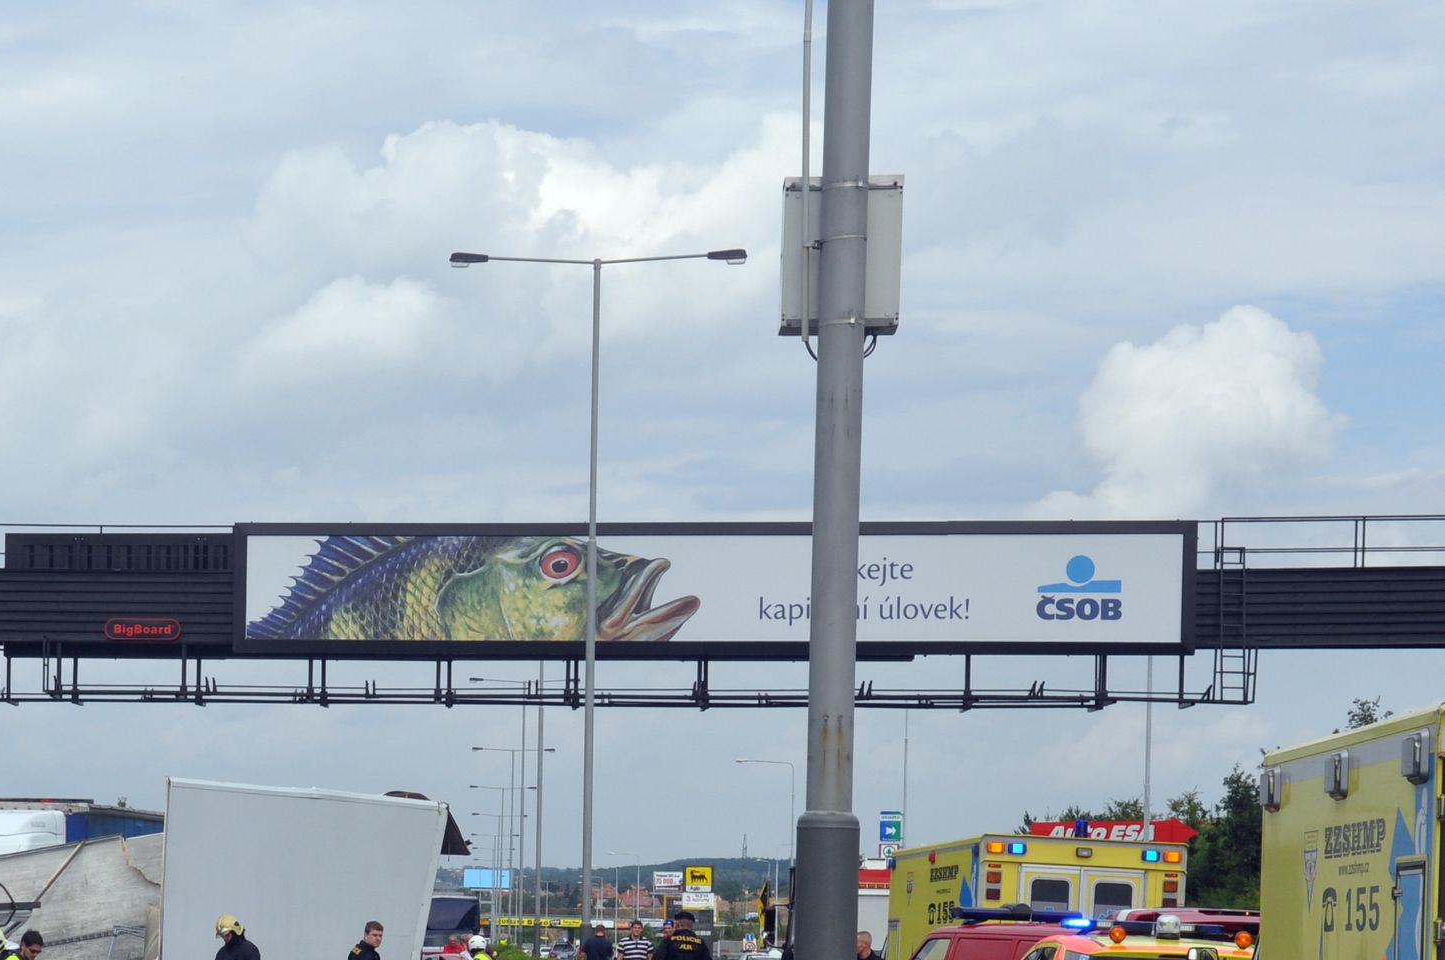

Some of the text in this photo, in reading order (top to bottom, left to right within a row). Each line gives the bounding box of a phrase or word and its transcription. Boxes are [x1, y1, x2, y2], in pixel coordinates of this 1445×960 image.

[857, 556, 914, 587] kejte
[879, 596, 970, 620] úlovek!
[1036, 595, 1123, 621] ČSOB
[113, 623, 172, 638] BigBoard
[1324, 818, 1386, 858] ZZSHMP
[937, 900, 955, 925] 155
[1345, 885, 1380, 932] 155
